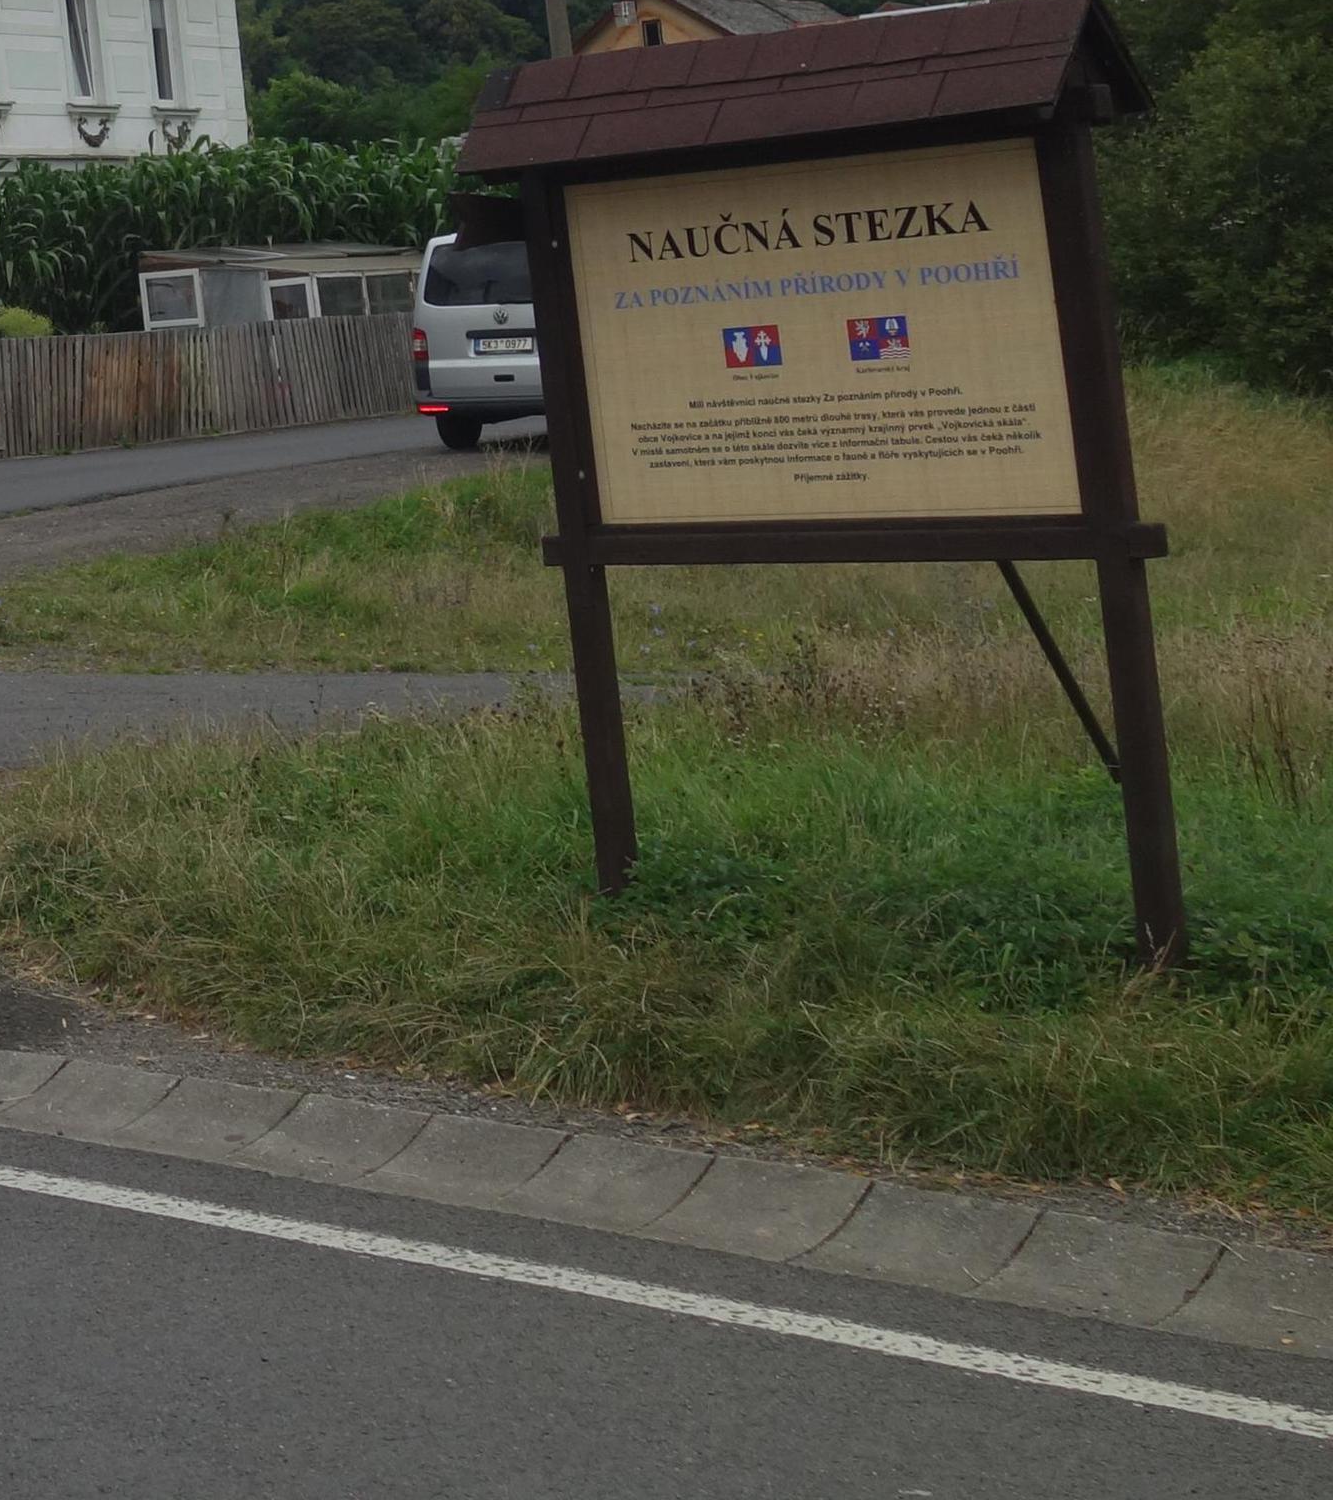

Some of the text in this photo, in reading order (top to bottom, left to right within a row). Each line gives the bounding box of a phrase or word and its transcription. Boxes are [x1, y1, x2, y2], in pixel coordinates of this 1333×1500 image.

[626, 200, 992, 263] NAUČNÁ STEZKA
[614, 253, 1020, 309] ZA POZNÁNÍM PŘÍRODY V POOHŘÍ
[505, 338, 527, 349] 0977
